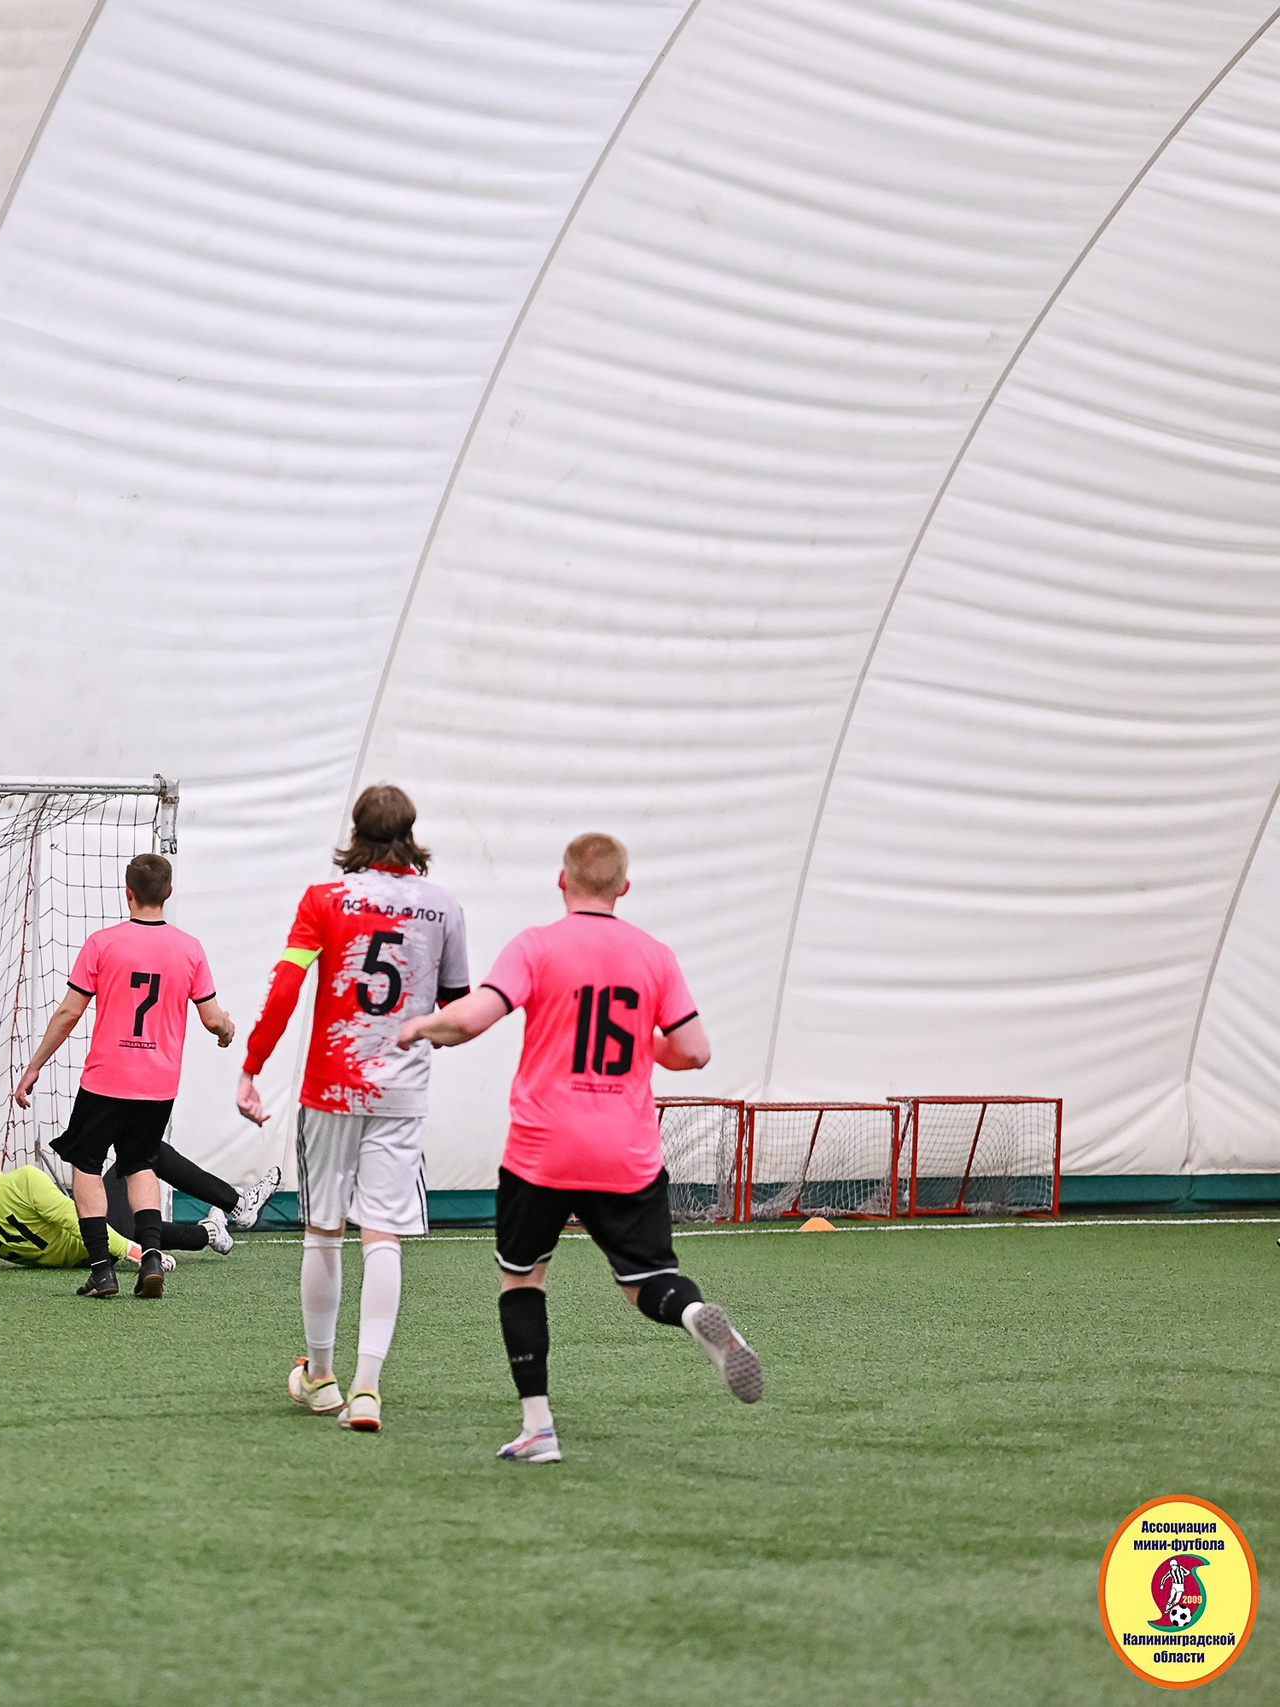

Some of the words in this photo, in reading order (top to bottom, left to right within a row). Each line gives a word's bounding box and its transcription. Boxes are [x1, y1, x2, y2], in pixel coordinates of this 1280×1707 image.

[130, 971, 161, 1037] 7
[356, 930, 404, 1017] 5
[572, 984, 639, 1076] 16
